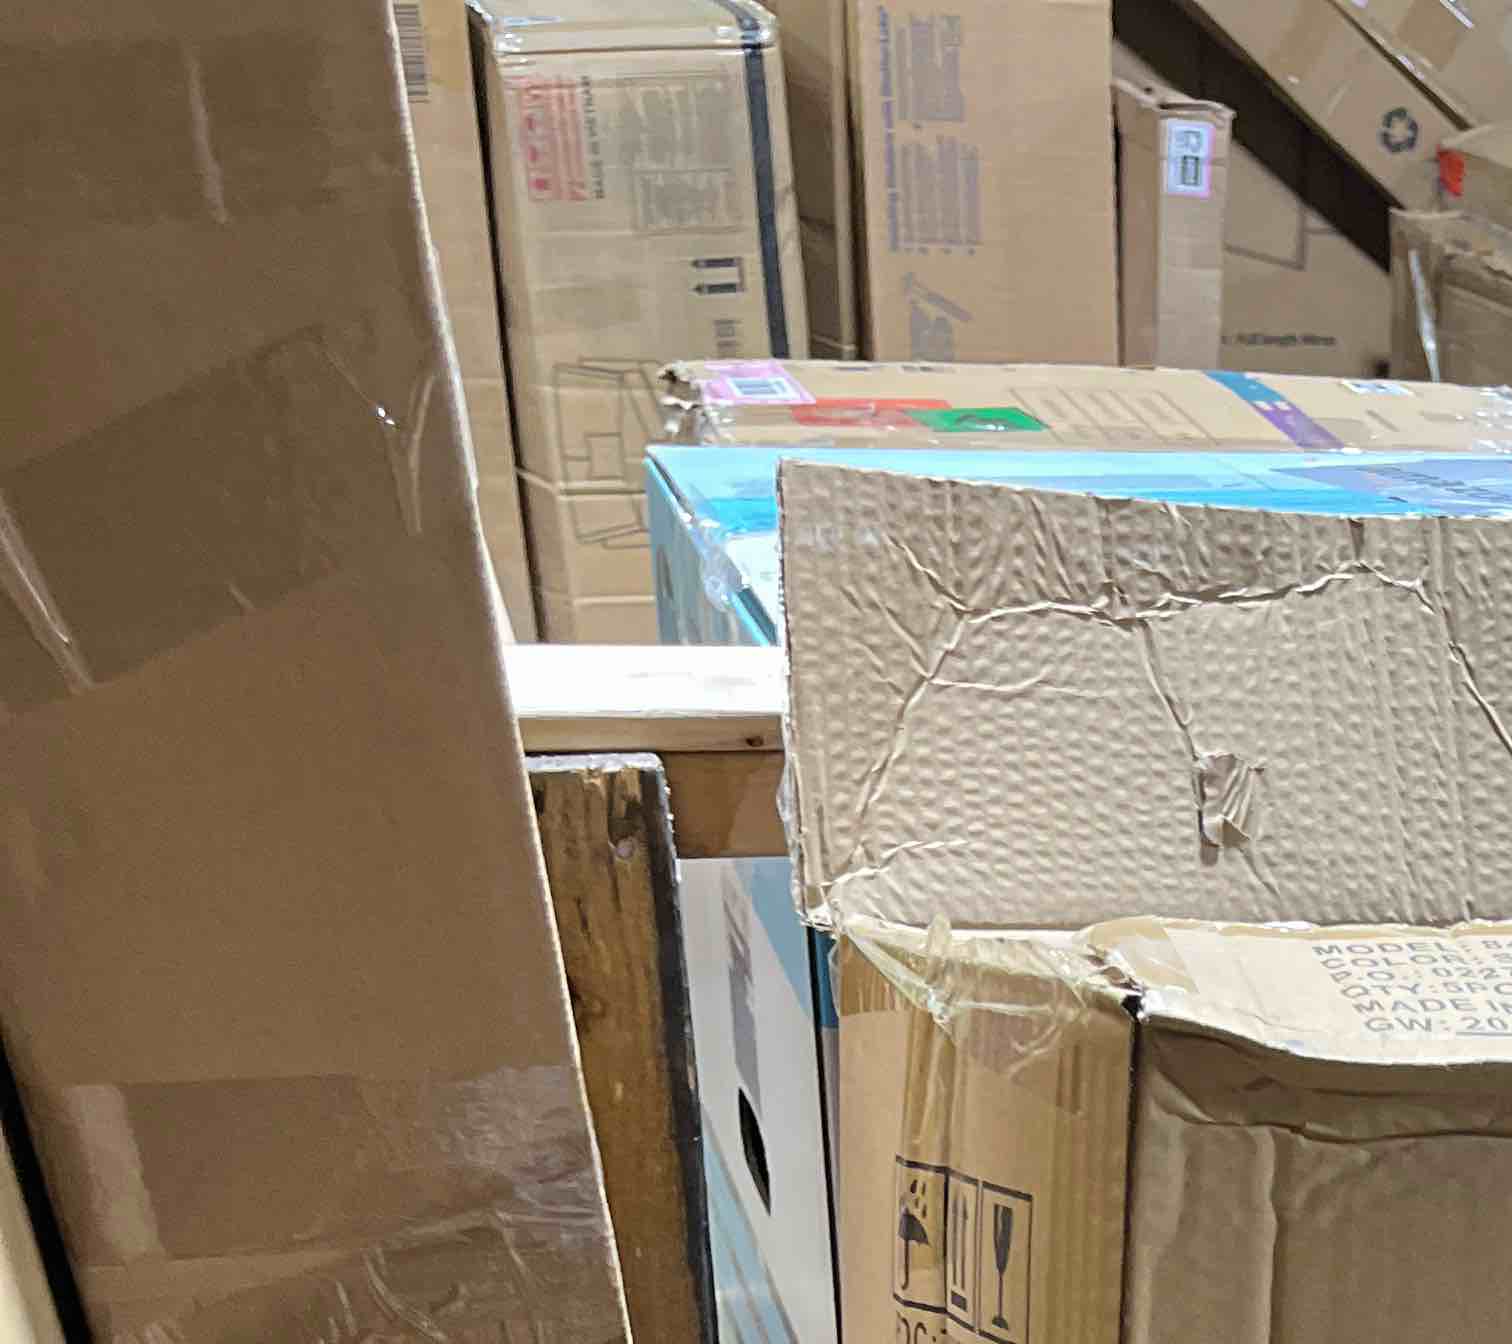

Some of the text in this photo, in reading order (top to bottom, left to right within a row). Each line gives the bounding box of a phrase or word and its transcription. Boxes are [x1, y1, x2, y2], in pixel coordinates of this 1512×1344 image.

[1312, 941, 1472, 957] MODEL:
[1352, 999, 1478, 1016] MADE
[1363, 1016, 1451, 1034] GW:
